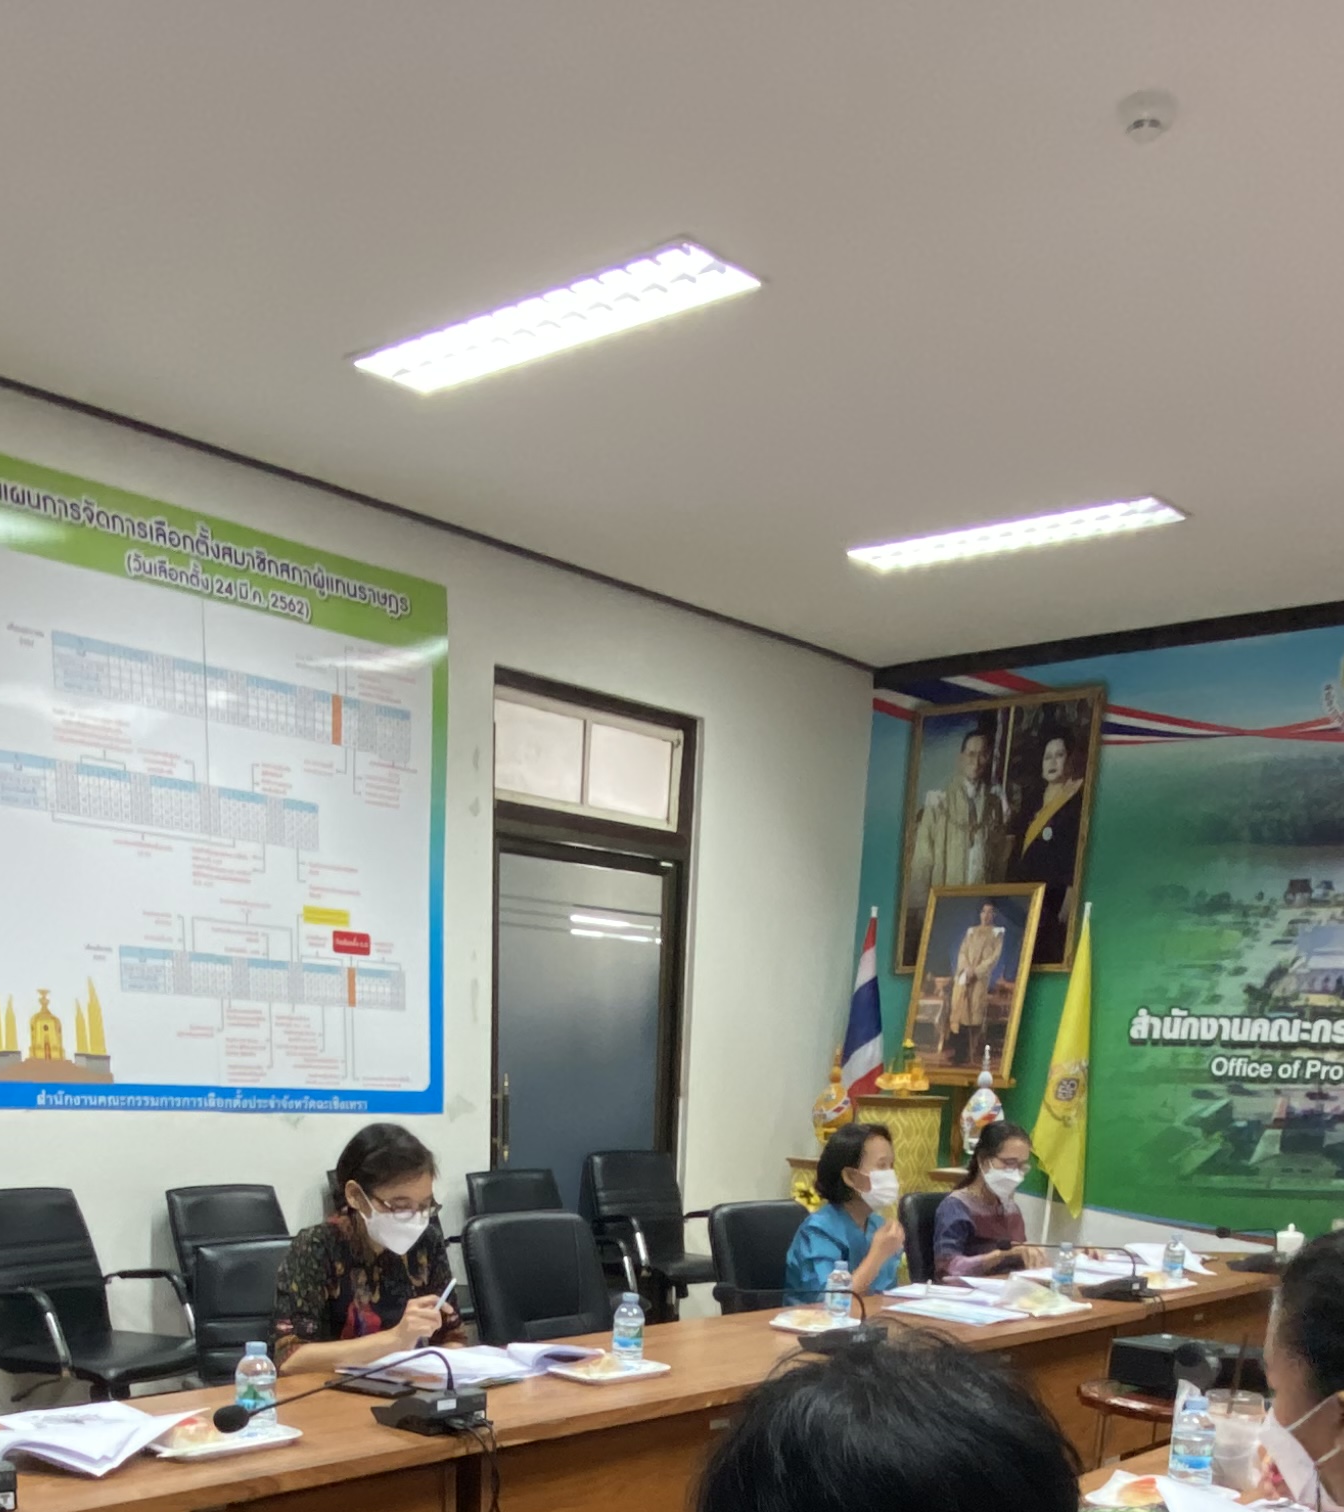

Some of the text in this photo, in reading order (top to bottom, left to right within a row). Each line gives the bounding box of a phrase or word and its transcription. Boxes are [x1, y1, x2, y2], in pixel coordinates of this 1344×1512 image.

[215, 578, 234, 597] 24
[269, 591, 310, 620] 2562)
[1210, 1056, 1273, 1078] Office
[1277, 1059, 1301, 1079] of
